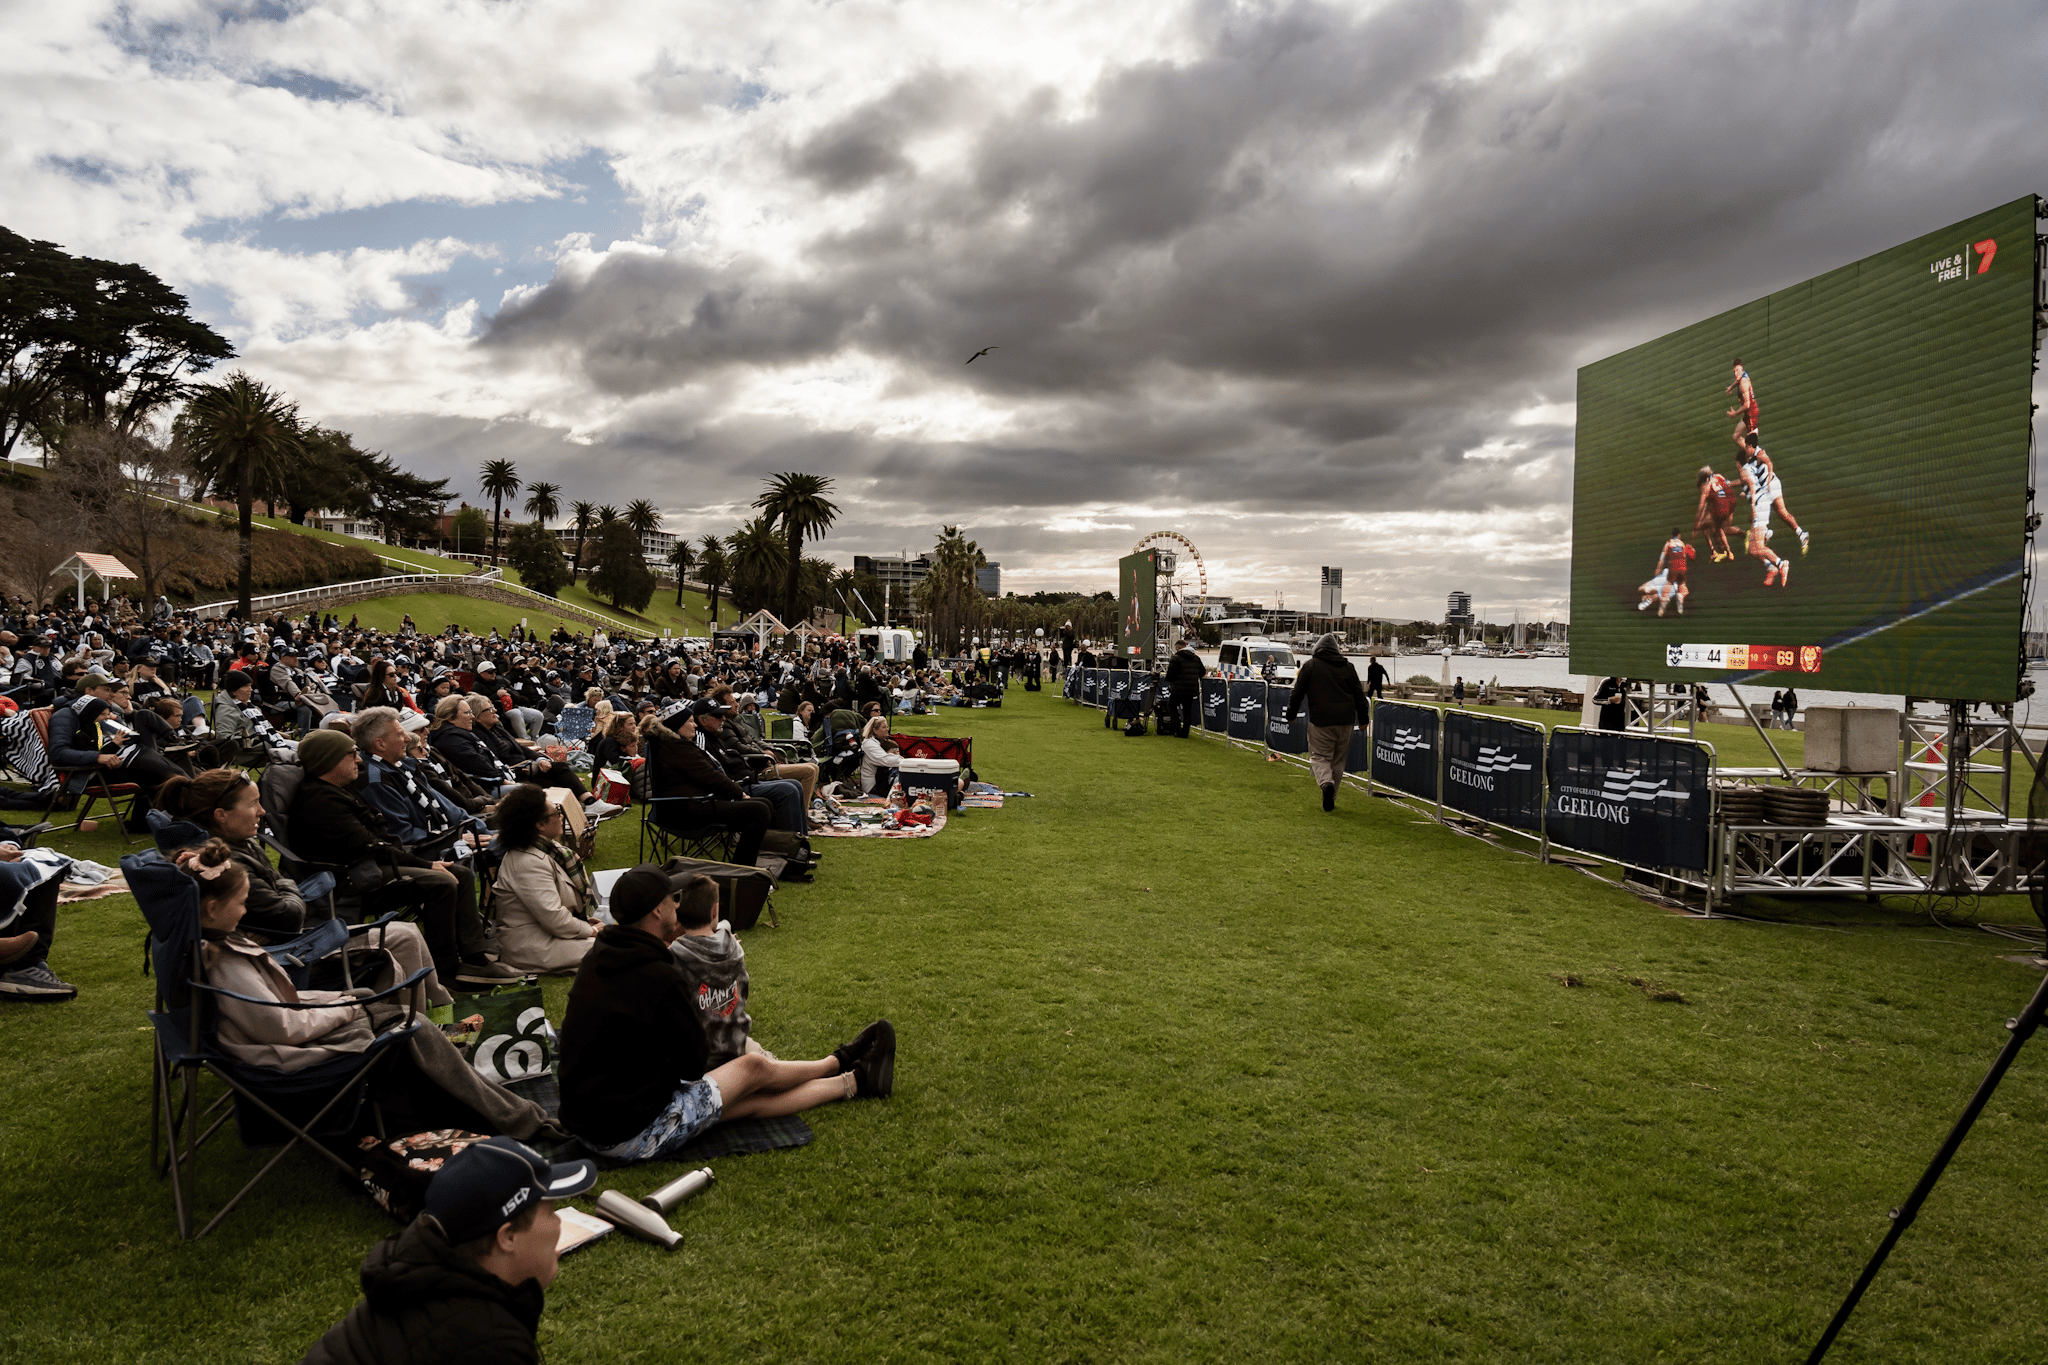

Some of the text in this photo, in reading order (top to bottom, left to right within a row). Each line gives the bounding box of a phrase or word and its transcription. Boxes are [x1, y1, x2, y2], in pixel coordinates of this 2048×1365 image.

[1930, 254, 1962, 274] LIVE &
[1974, 238, 1998, 275] 7
[1938, 265, 1962, 283] FREE
[1707, 649, 1721, 663] 44
[1732, 647, 1744, 655] 4TH
[1750, 650, 1795, 666] 10 9 69
[1376, 745, 1406, 767] GEELONG
[1450, 765, 1494, 792] GEELONG
[1560, 785, 1601, 797] CITY OF GREATER
[1558, 795, 1630, 825] GEELONG
